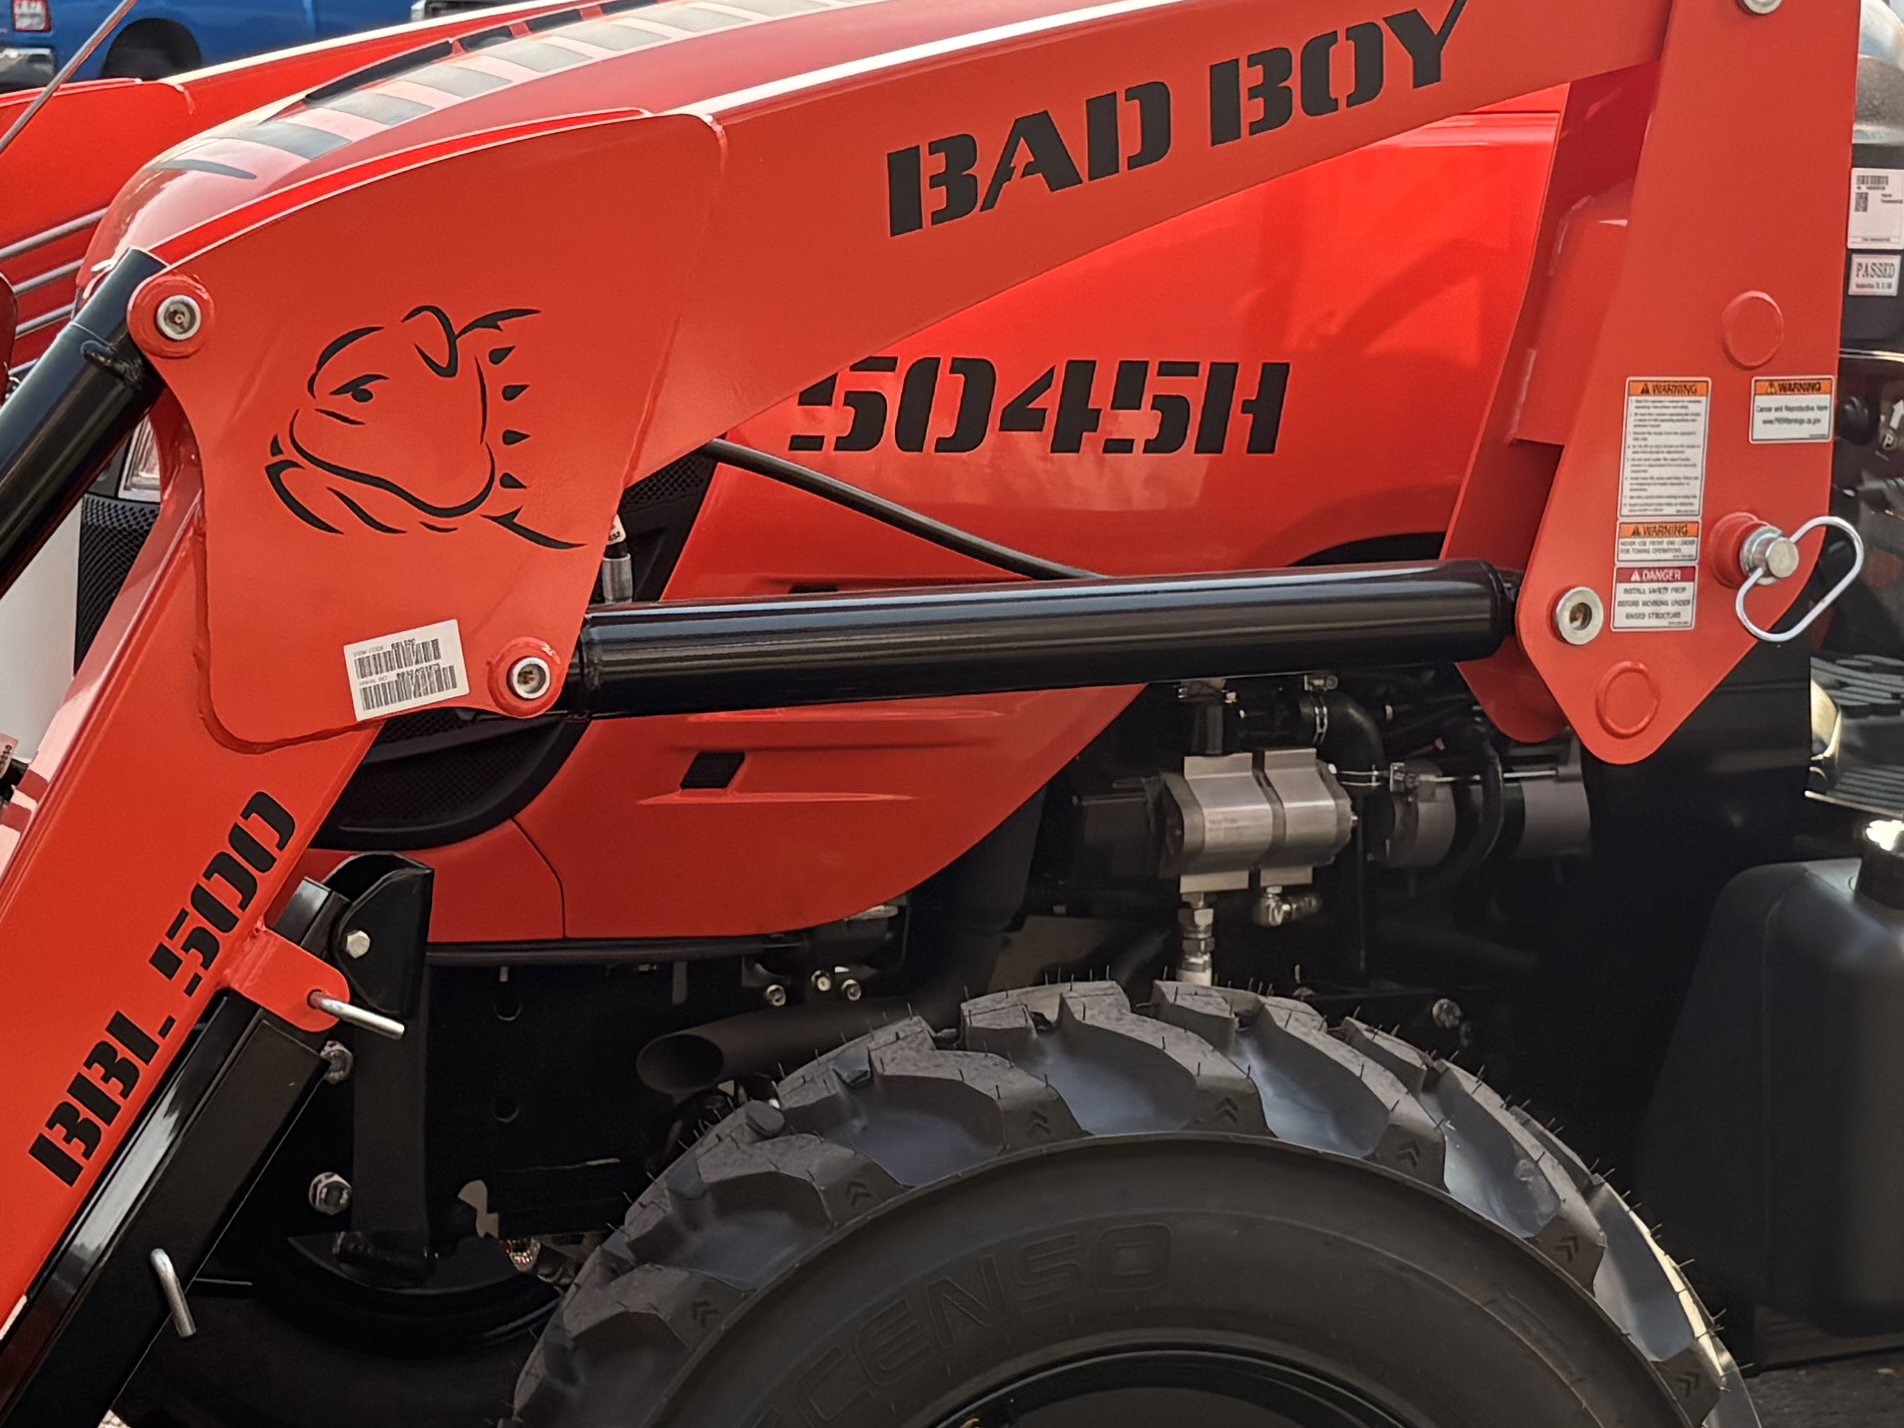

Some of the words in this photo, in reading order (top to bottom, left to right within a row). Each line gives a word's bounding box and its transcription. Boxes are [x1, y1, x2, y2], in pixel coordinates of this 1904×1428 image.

[887, 80, 1172, 238] BAD
[1855, 262, 1896, 279] PASSED
[1651, 382, 1698, 395] WARNING
[1777, 381, 1822, 393] WARNING
[787, 355, 1291, 455] 5045H
[1642, 524, 1688, 537] WARNING
[1642, 569, 1682, 582] DANGER
[28, 1010, 176, 1188] BBL
[148, 790, 297, 998] 500
